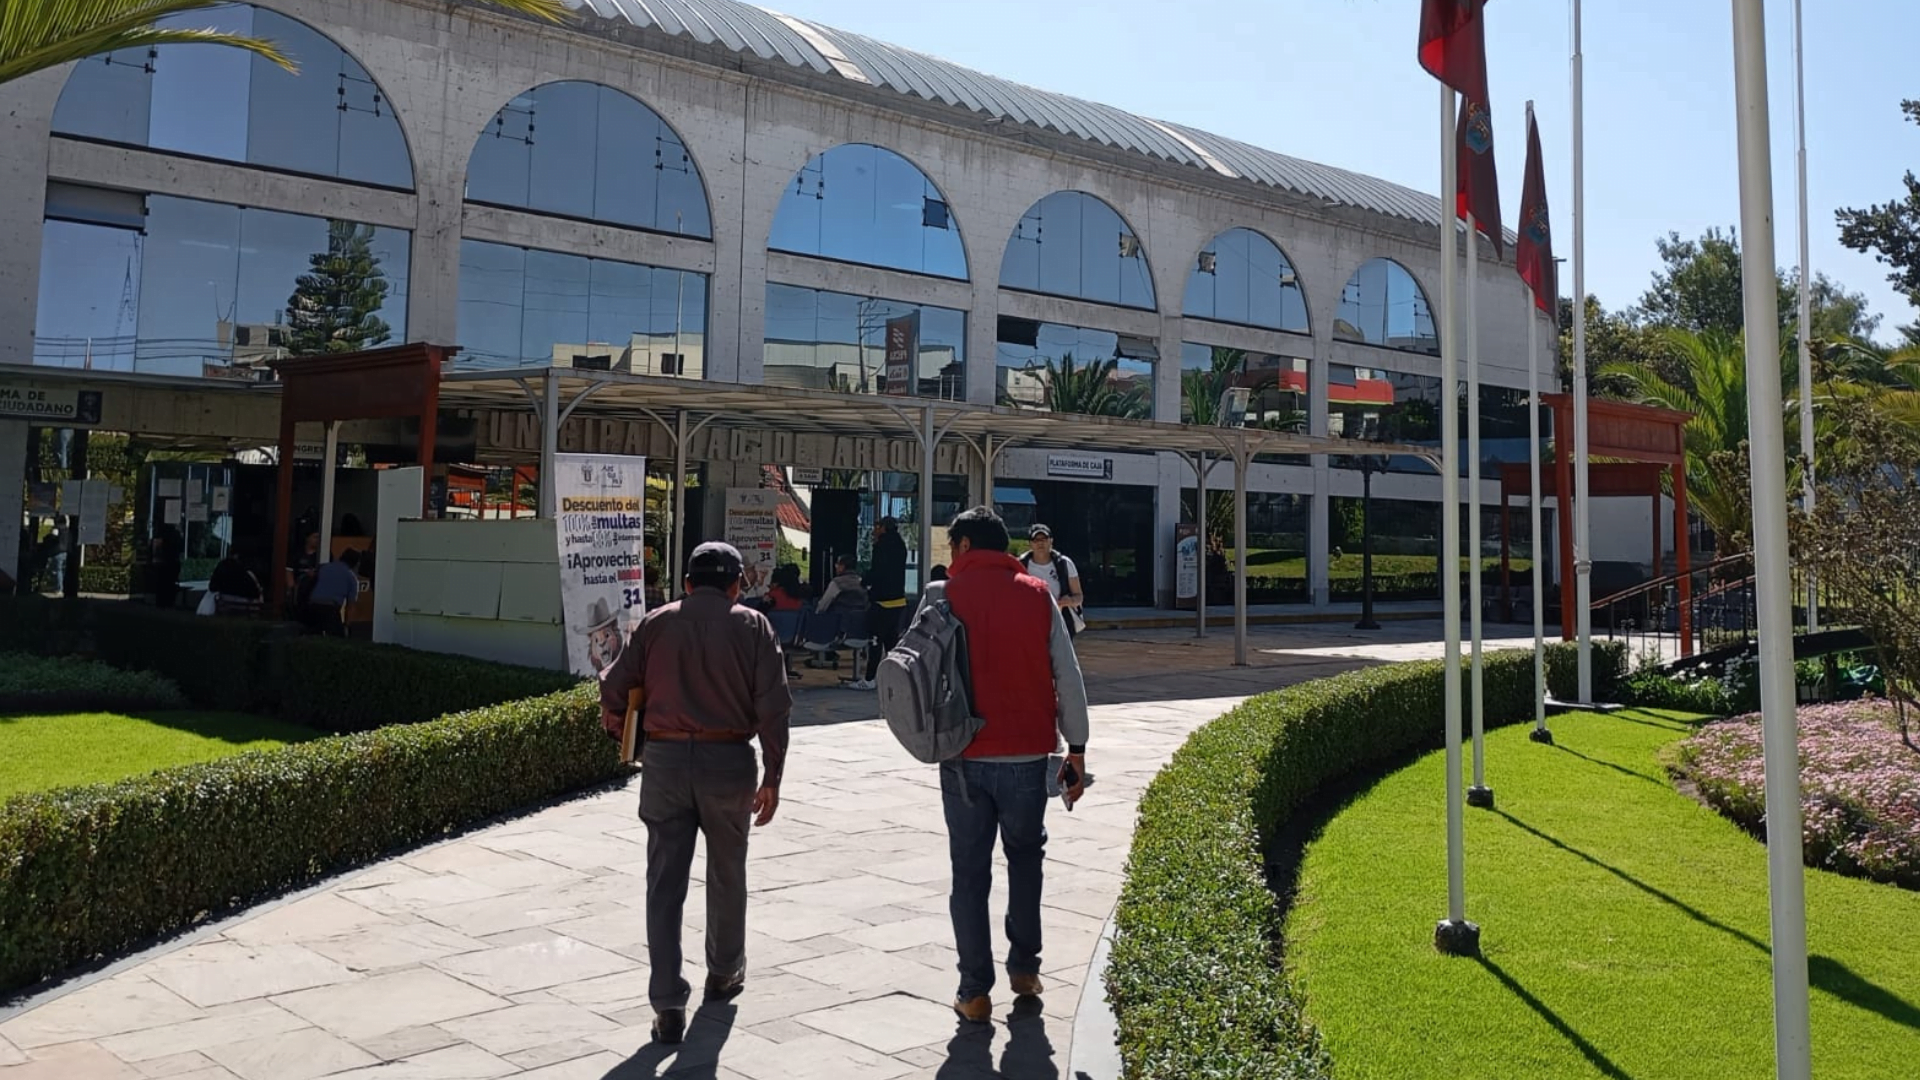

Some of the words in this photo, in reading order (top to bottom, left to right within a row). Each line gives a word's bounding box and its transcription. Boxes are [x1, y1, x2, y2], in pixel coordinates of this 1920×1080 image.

[28, 391, 46, 401] DE
[0, 400, 73, 414] IUDADANO
[832, 434, 969, 475] AREQUPA
[562, 497, 624, 512] Descuento
[625, 499, 640, 512] del
[597, 513, 641, 529] multas
[565, 536, 571, 547] y
[571, 534, 592, 543] hasta
[567, 551, 641, 572] ¡Aprovecha!
[760, 552, 771, 562] 31
[583, 572, 607, 585] hasta
[623, 588, 642, 609] 31
